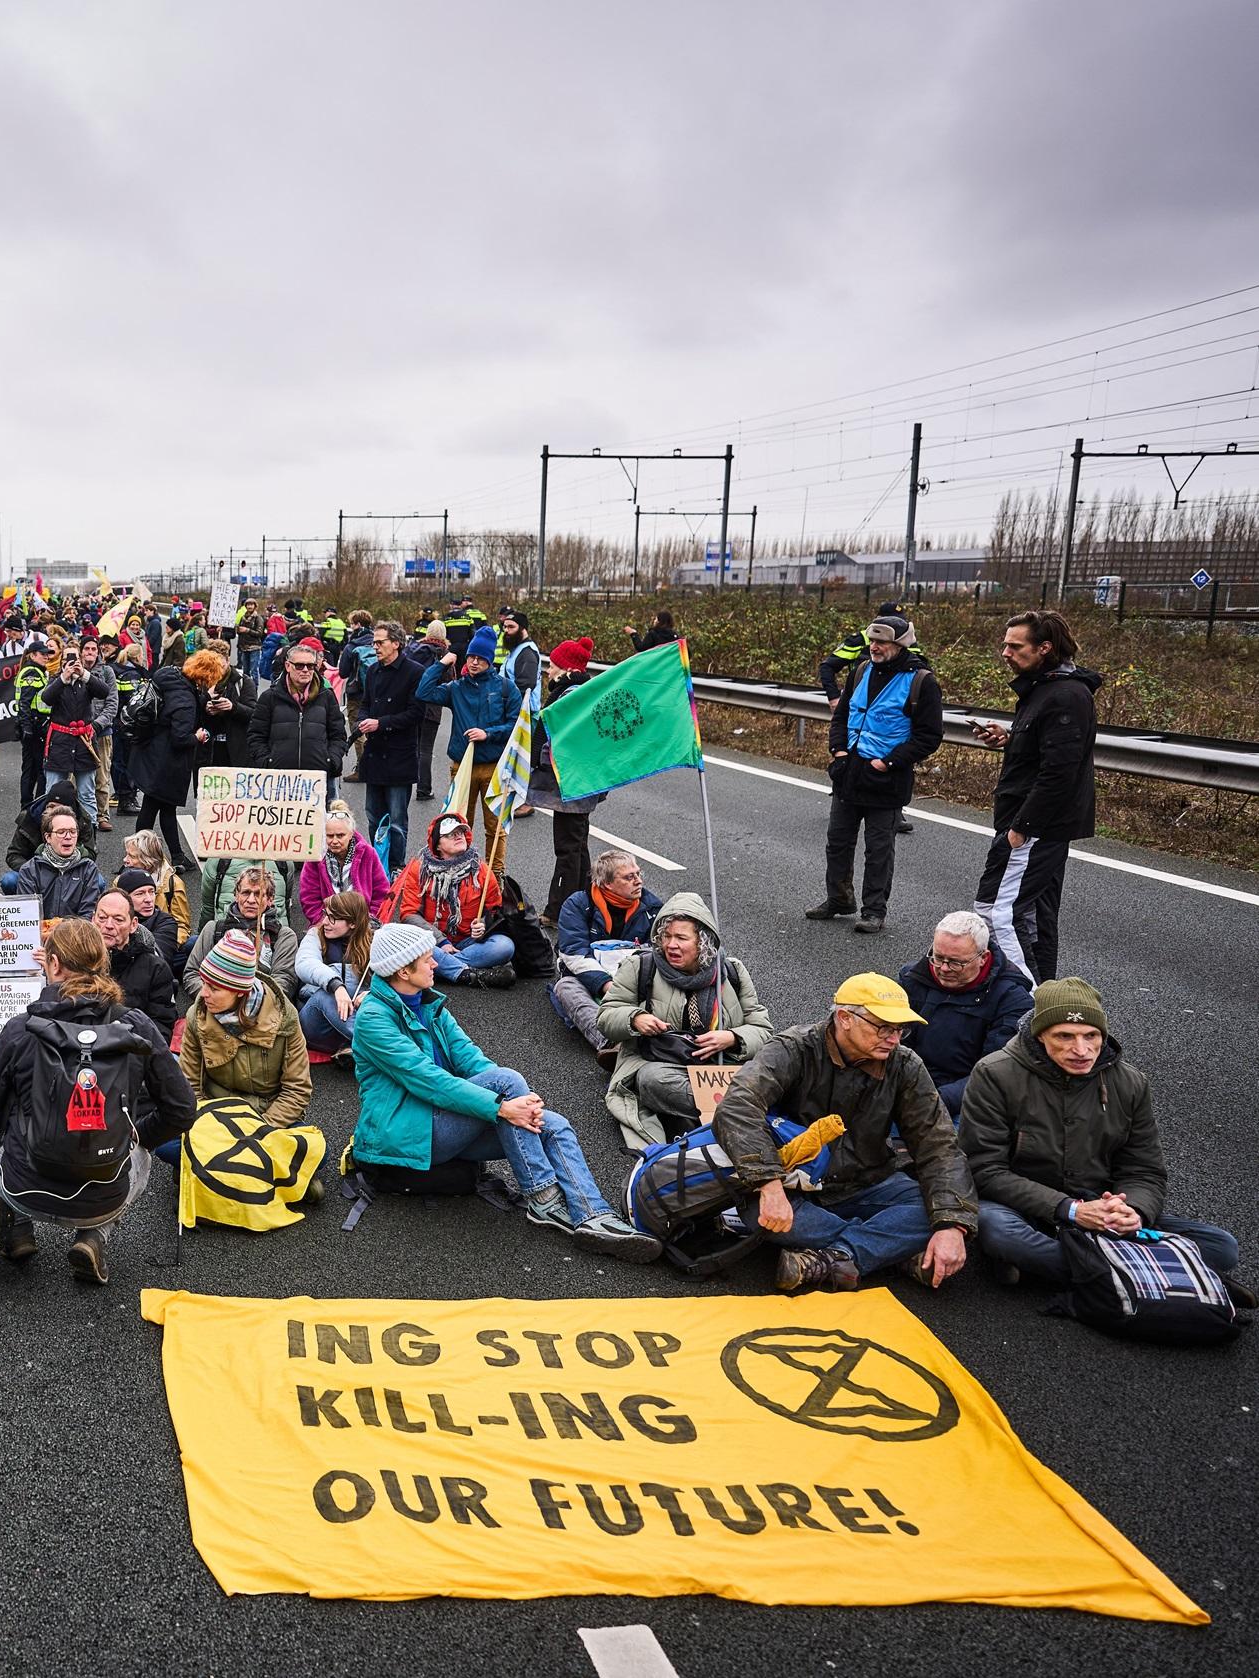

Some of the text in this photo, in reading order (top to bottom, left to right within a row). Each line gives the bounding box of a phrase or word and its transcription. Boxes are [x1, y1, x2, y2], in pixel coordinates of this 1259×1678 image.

[217, 584, 238, 595] HIER
[212, 610, 231, 618] NIET
[203, 775, 230, 800] RED
[210, 803, 315, 826] STOP FOSSIELE
[287, 1319, 681, 1369] ING STOP
[295, 1384, 697, 1444] KILL-ING
[312, 1469, 920, 1537] OUR FUTURE!
